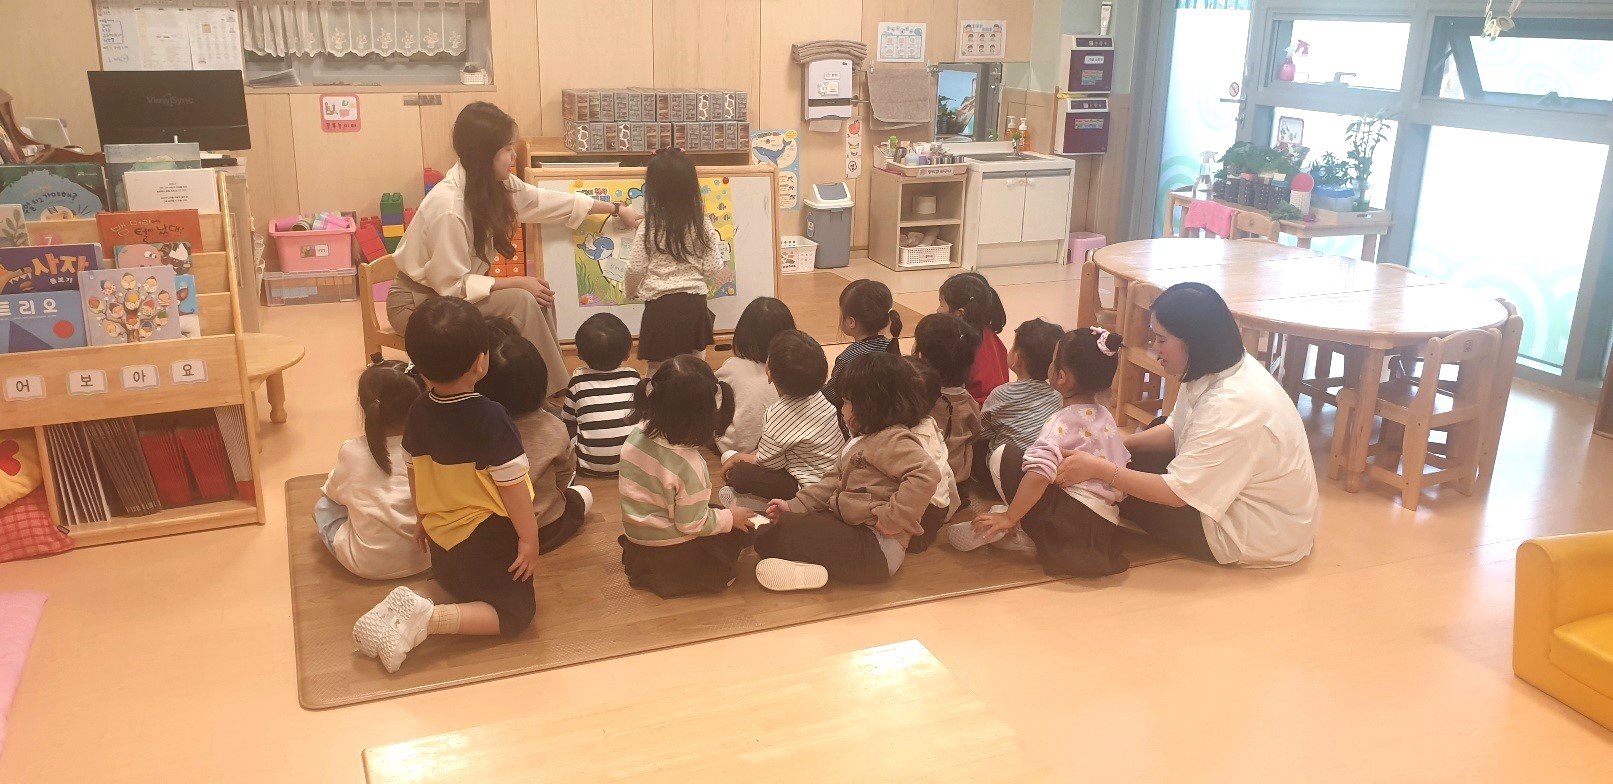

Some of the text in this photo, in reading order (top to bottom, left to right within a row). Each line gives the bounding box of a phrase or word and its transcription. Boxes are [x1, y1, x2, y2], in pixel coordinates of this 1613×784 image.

[32, 252, 89, 276] 사자
[16, 363, 195, 393] 어 보 아 요
